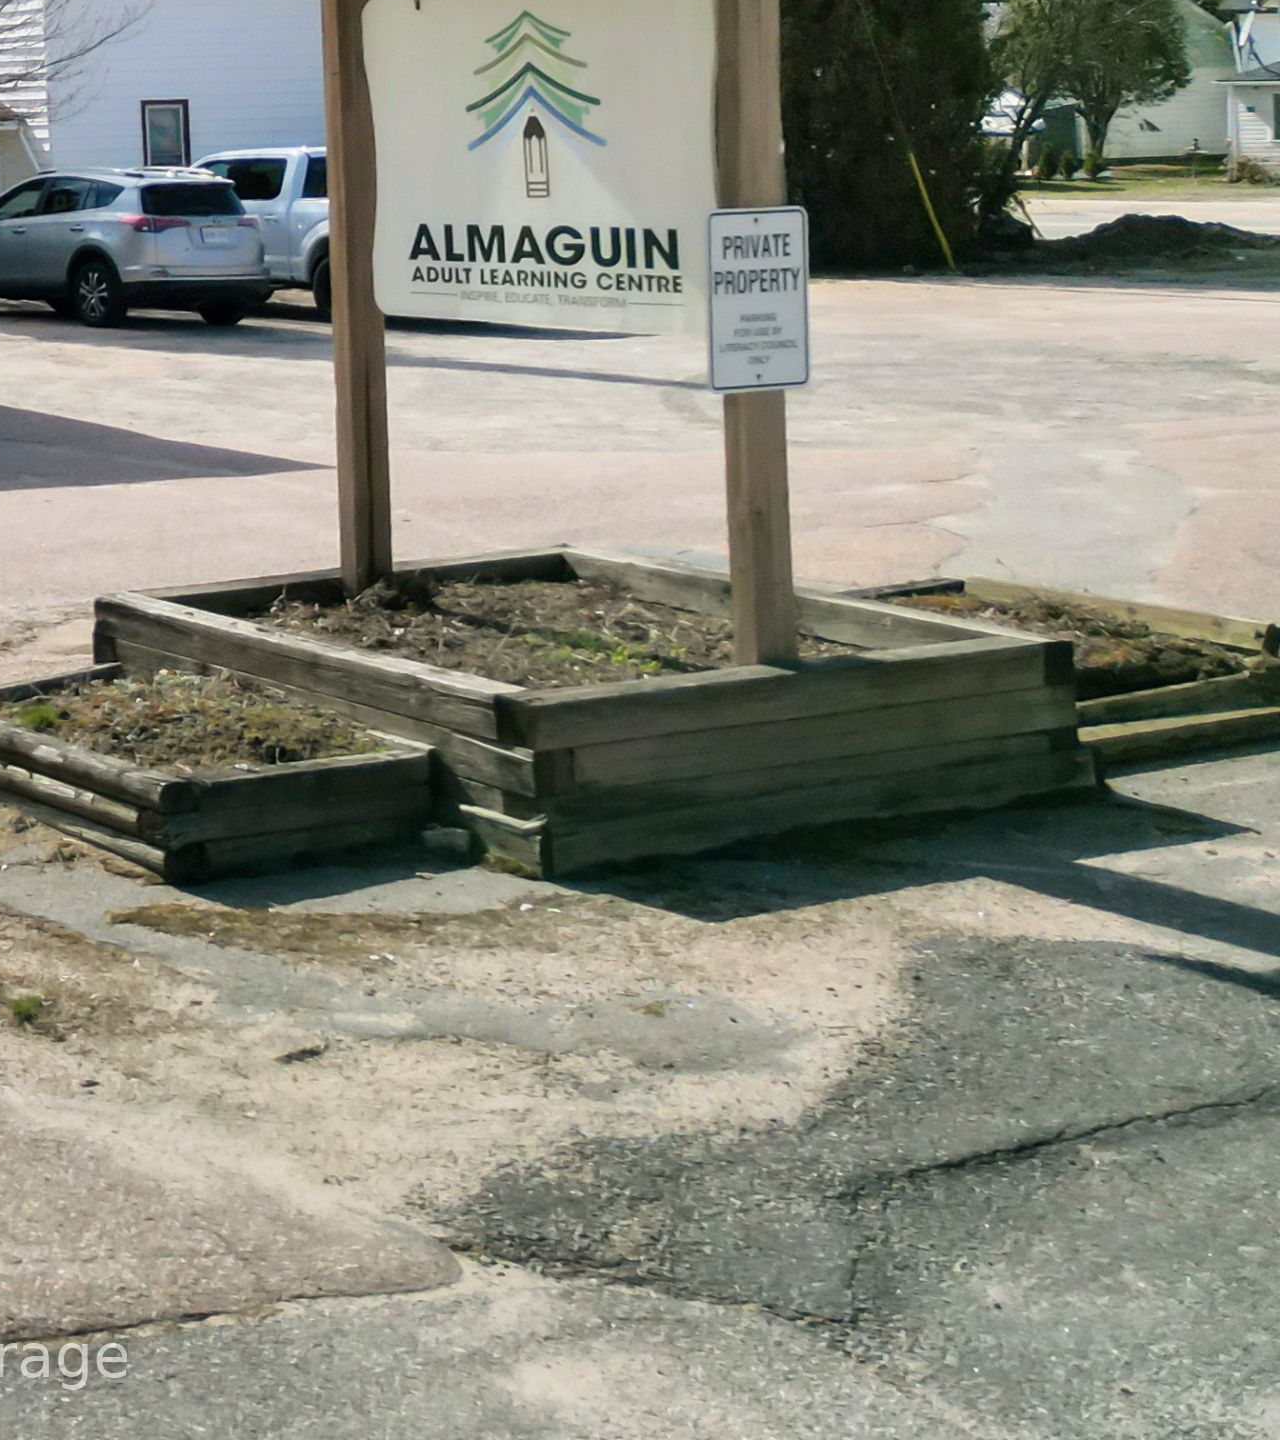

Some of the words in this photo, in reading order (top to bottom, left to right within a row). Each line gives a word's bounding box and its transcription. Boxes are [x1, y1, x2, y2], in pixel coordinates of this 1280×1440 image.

[408, 223, 680, 270] ALMAGUIN
[721, 233, 791, 260] PRIVATE
[411, 266, 472, 284] ADULT
[480, 267, 588, 290] LEARNING
[596, 272, 683, 294] CENTRE
[714, 267, 800, 295] PROPERTY
